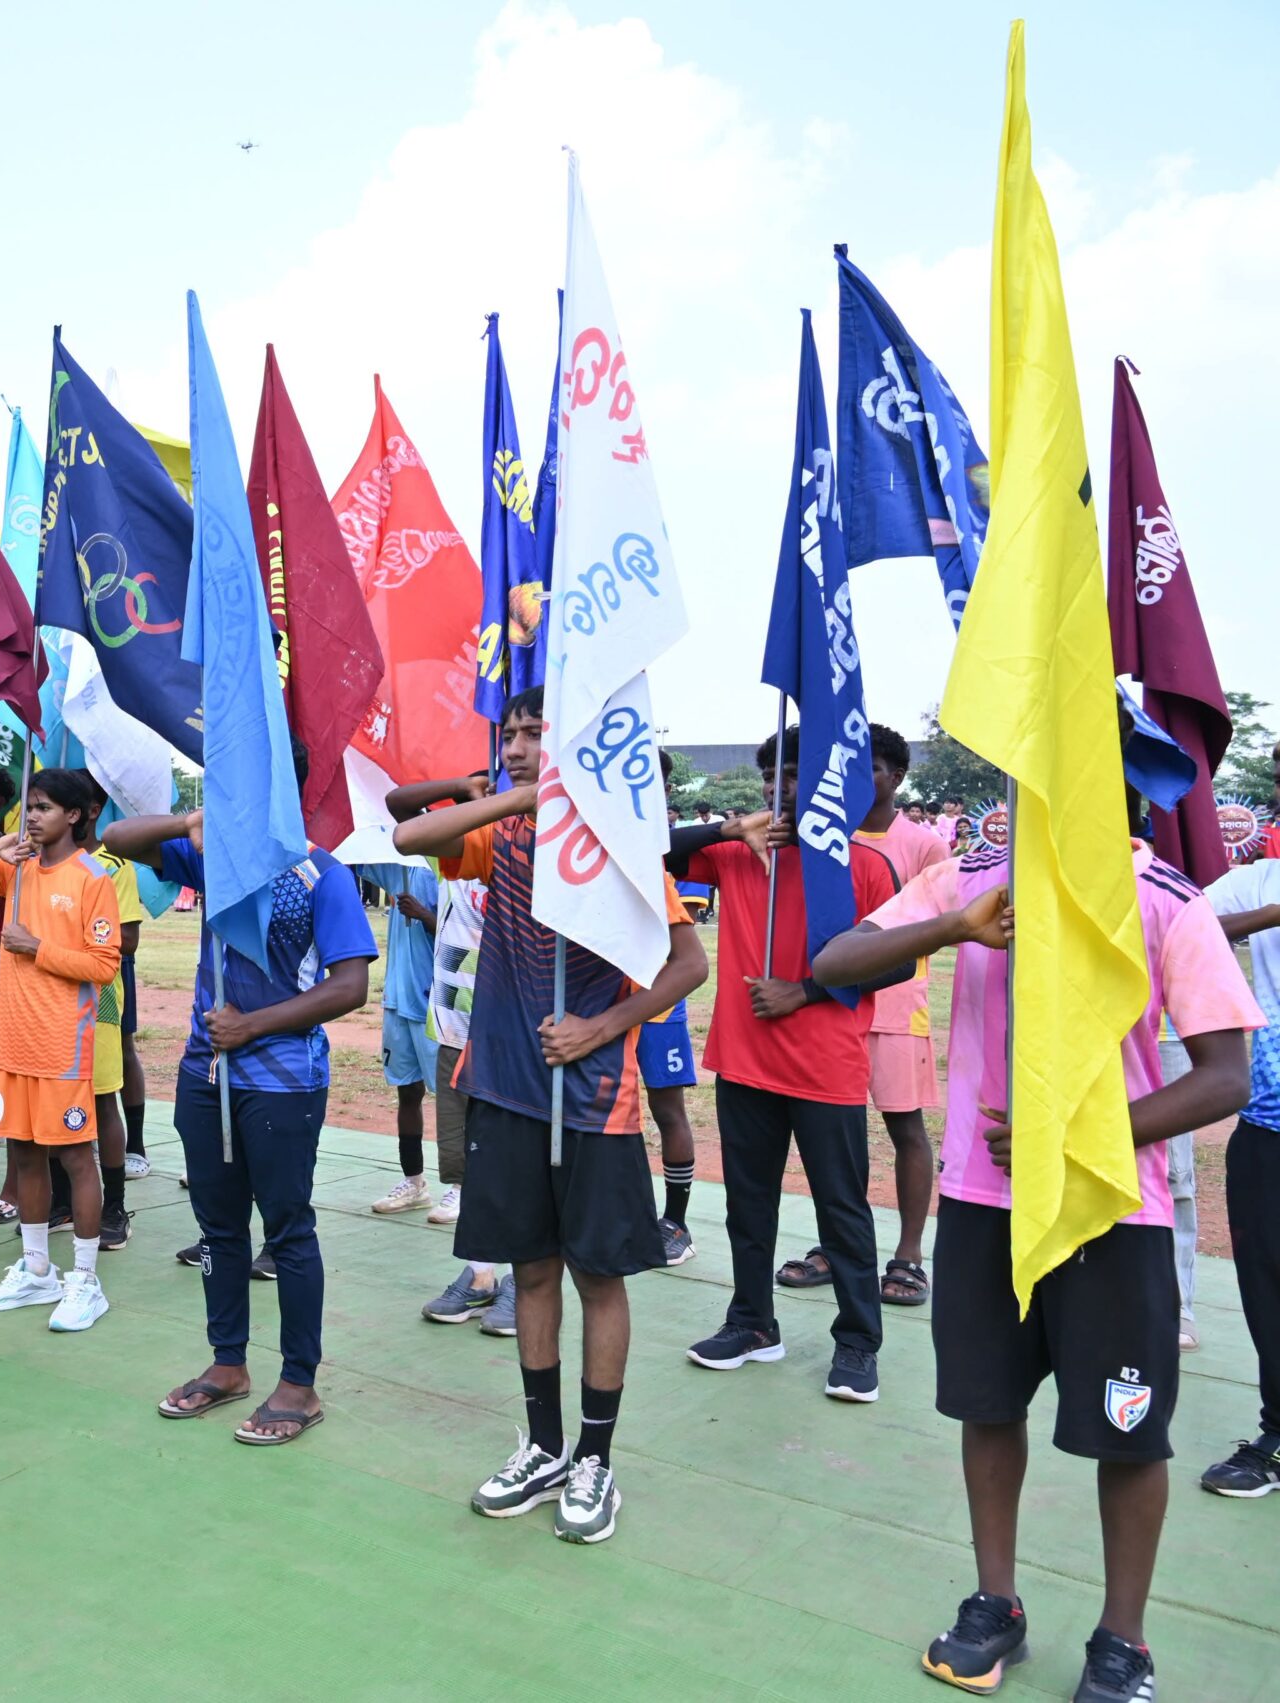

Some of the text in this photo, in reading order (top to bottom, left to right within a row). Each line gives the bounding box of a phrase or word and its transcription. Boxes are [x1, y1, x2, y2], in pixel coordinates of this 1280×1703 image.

[666, 1048, 684, 1073] 5
[1120, 1366, 1140, 1383] 42
[1114, 1386, 1138, 1398] INDIA
